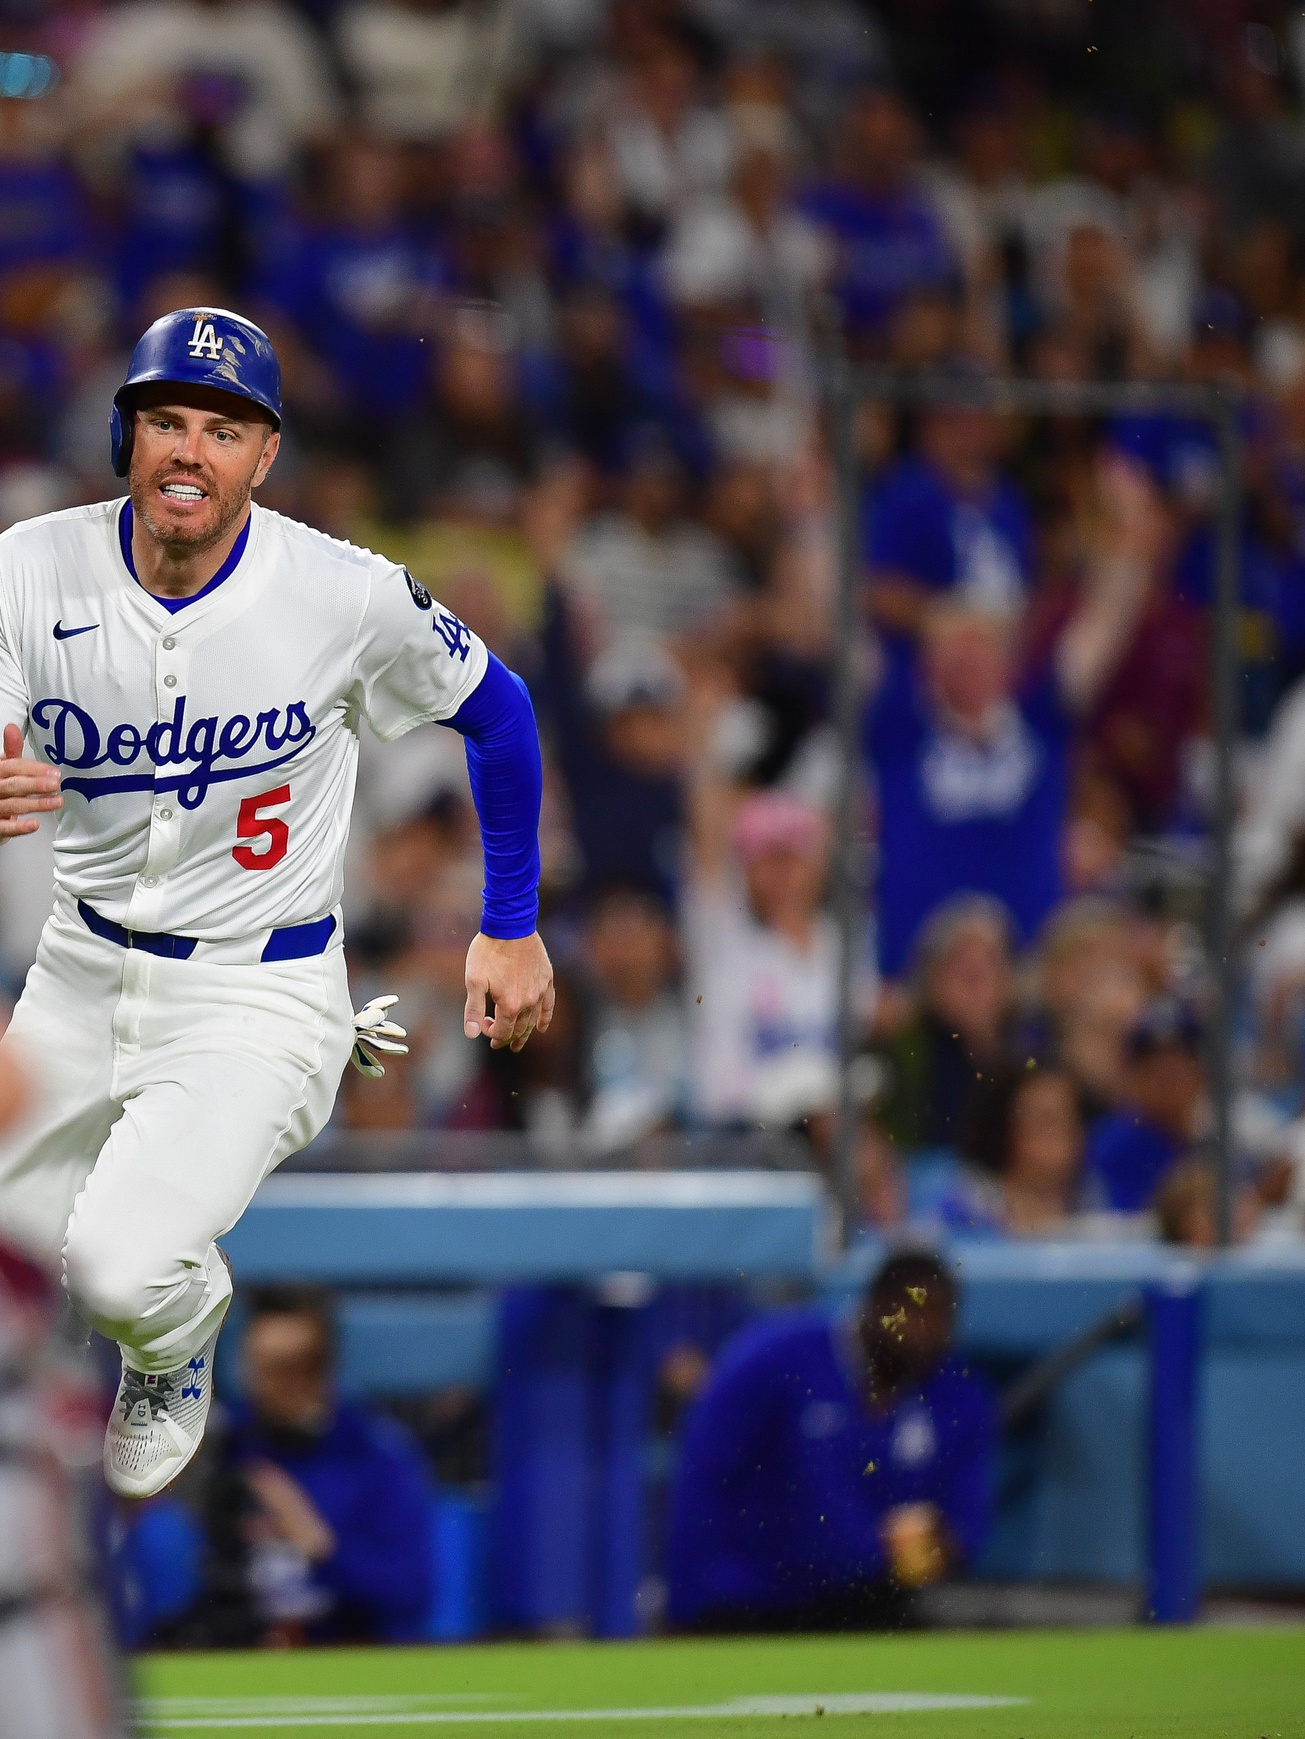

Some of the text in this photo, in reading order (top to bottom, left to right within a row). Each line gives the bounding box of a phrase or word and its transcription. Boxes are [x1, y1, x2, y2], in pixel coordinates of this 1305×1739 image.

[188, 314, 224, 361] LA
[432, 612, 471, 664] LA
[32, 695, 316, 811] Dodgers
[232, 784, 292, 871] 5
